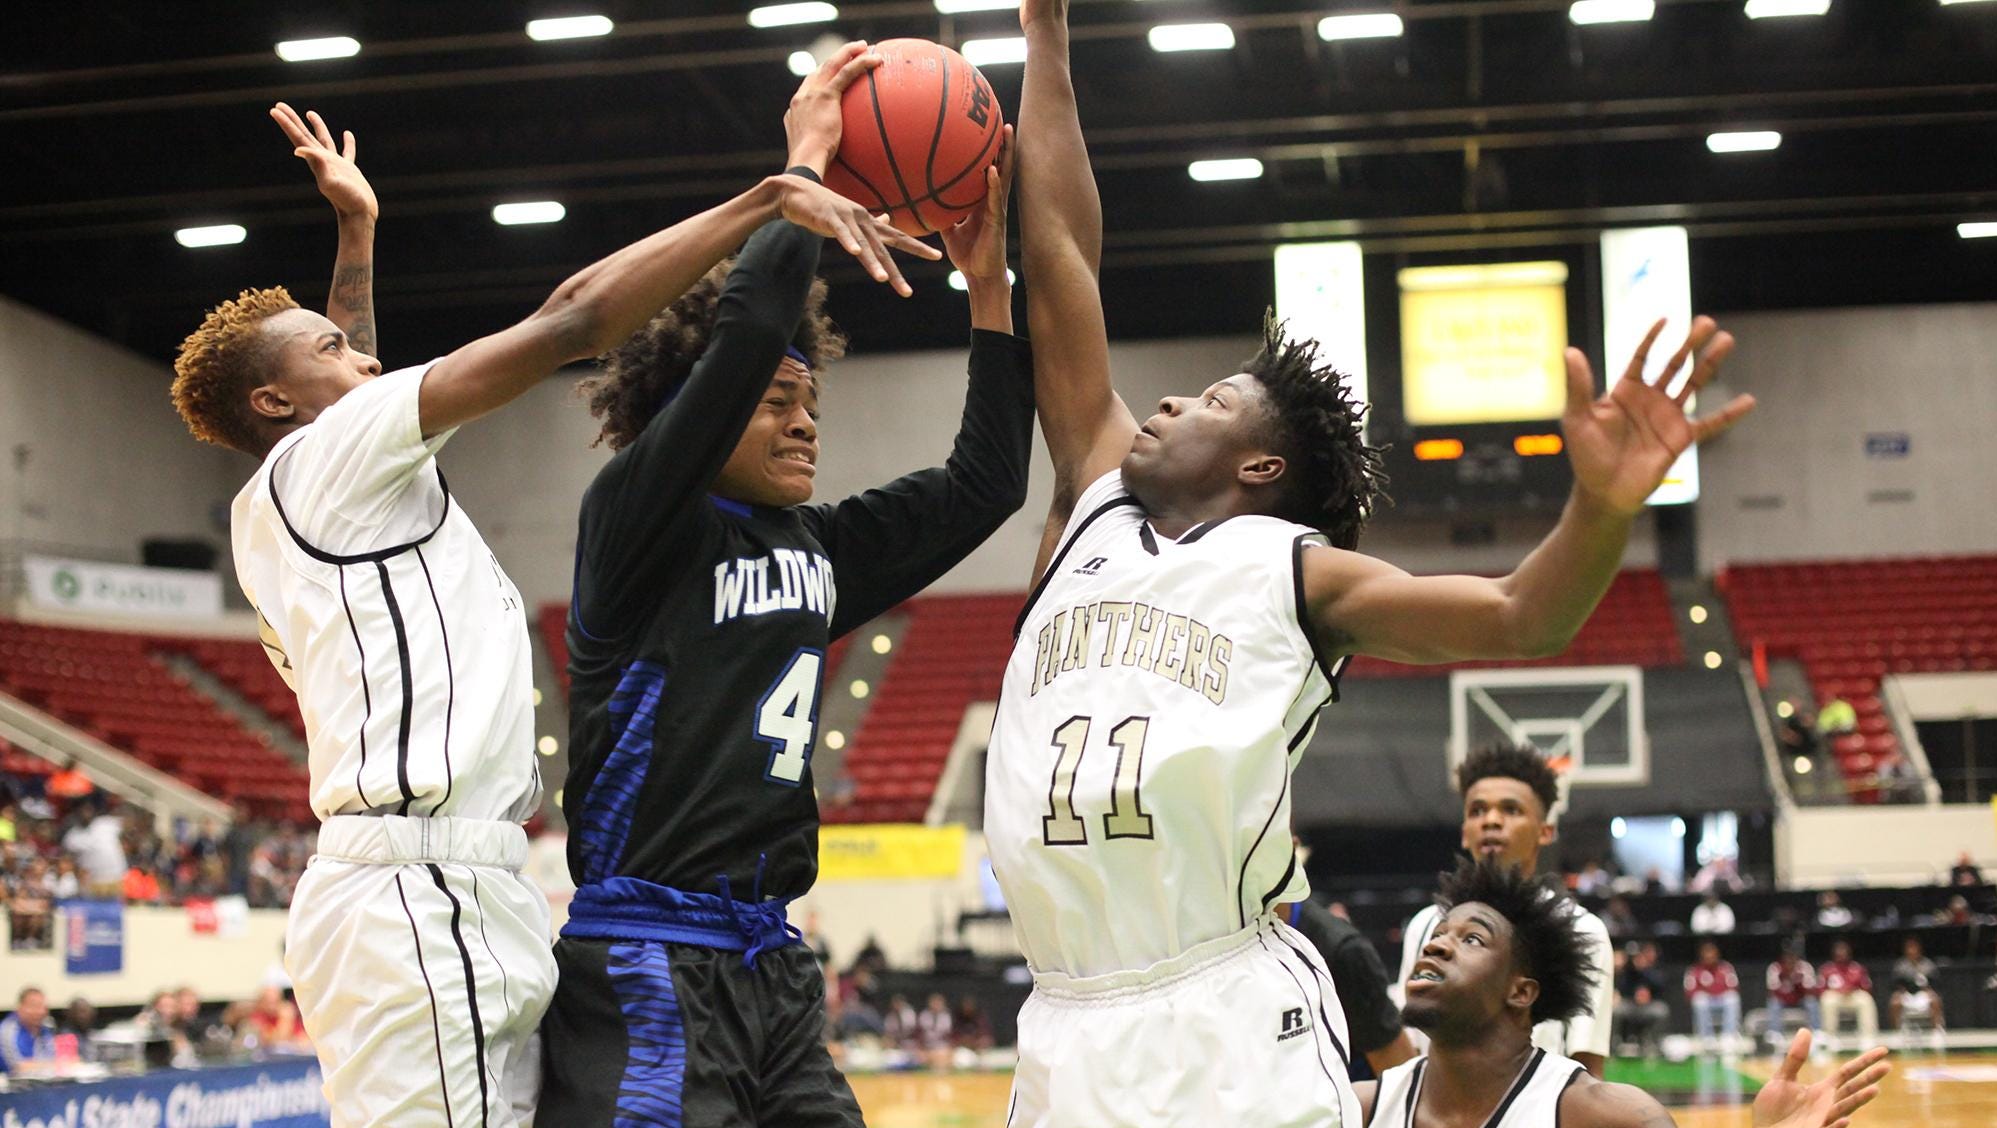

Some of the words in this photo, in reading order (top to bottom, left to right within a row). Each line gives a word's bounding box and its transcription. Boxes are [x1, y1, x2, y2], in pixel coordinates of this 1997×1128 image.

[752, 647, 825, 789] 4
[1030, 601, 1233, 706] PANTHERS
[1042, 715, 1155, 846] 11
